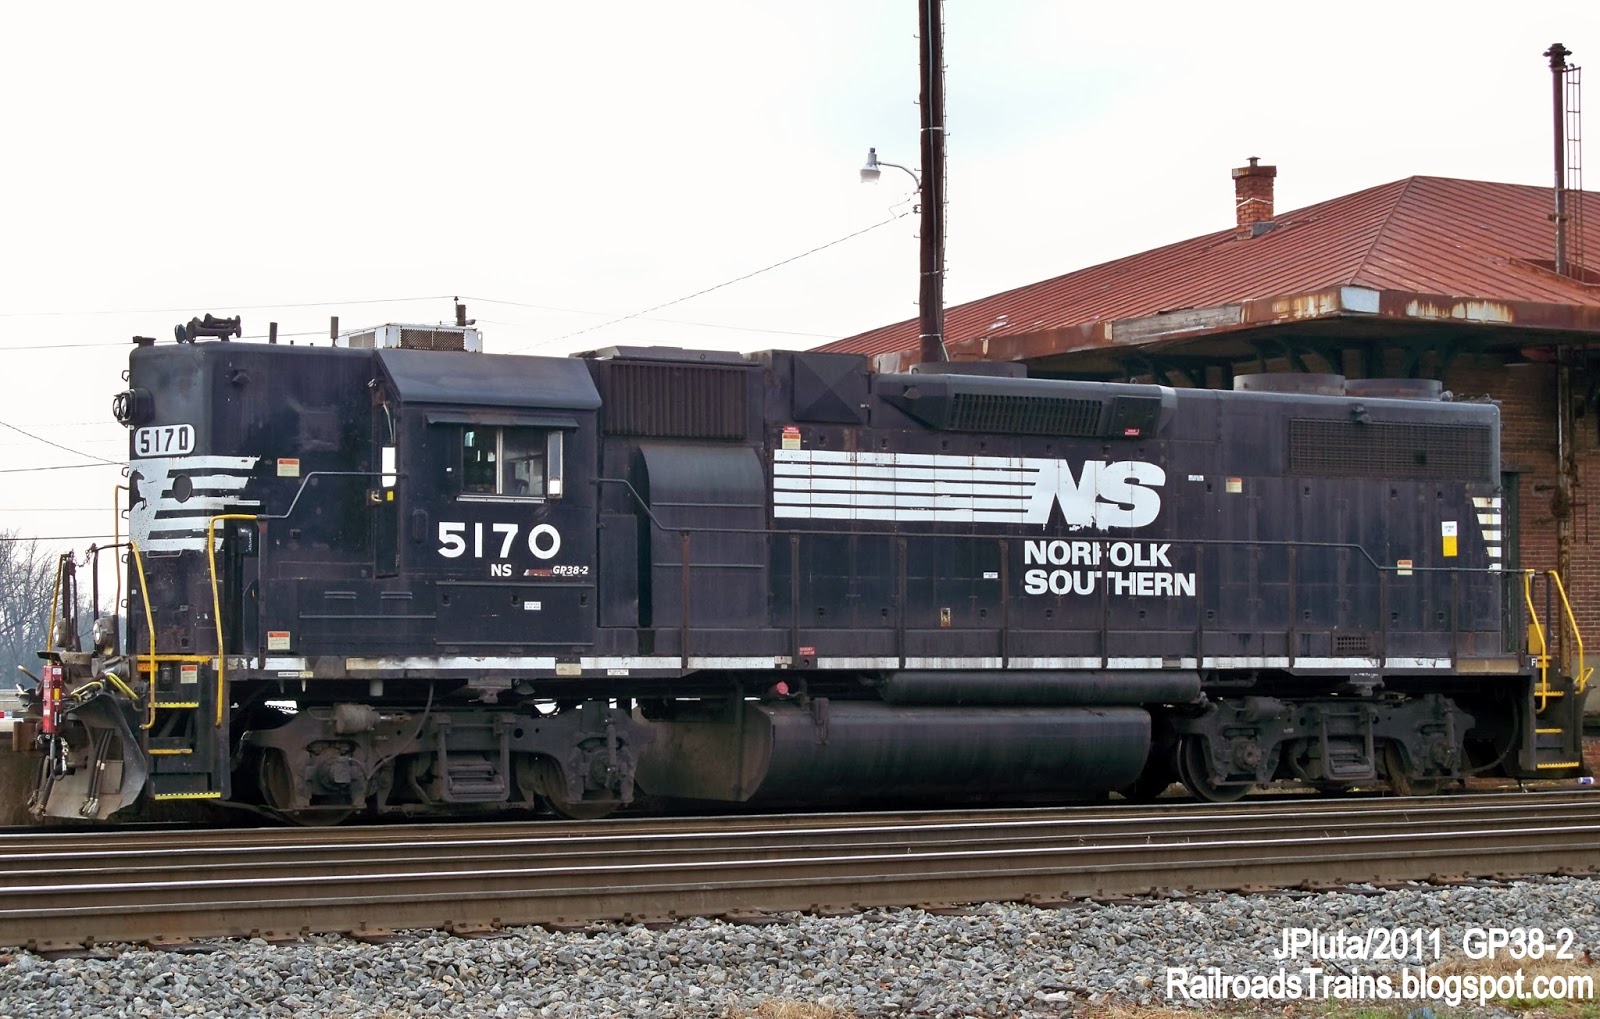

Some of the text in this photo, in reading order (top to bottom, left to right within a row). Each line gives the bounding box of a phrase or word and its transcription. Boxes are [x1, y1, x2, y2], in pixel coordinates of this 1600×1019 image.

[140, 427, 189, 453] 5170
[1027, 458, 1165, 529] NS
[437, 521, 561, 560] 5170
[1024, 540, 1172, 568] NORFOLK
[490, 563, 512, 577] NS
[552, 564, 589, 576] GP38-2
